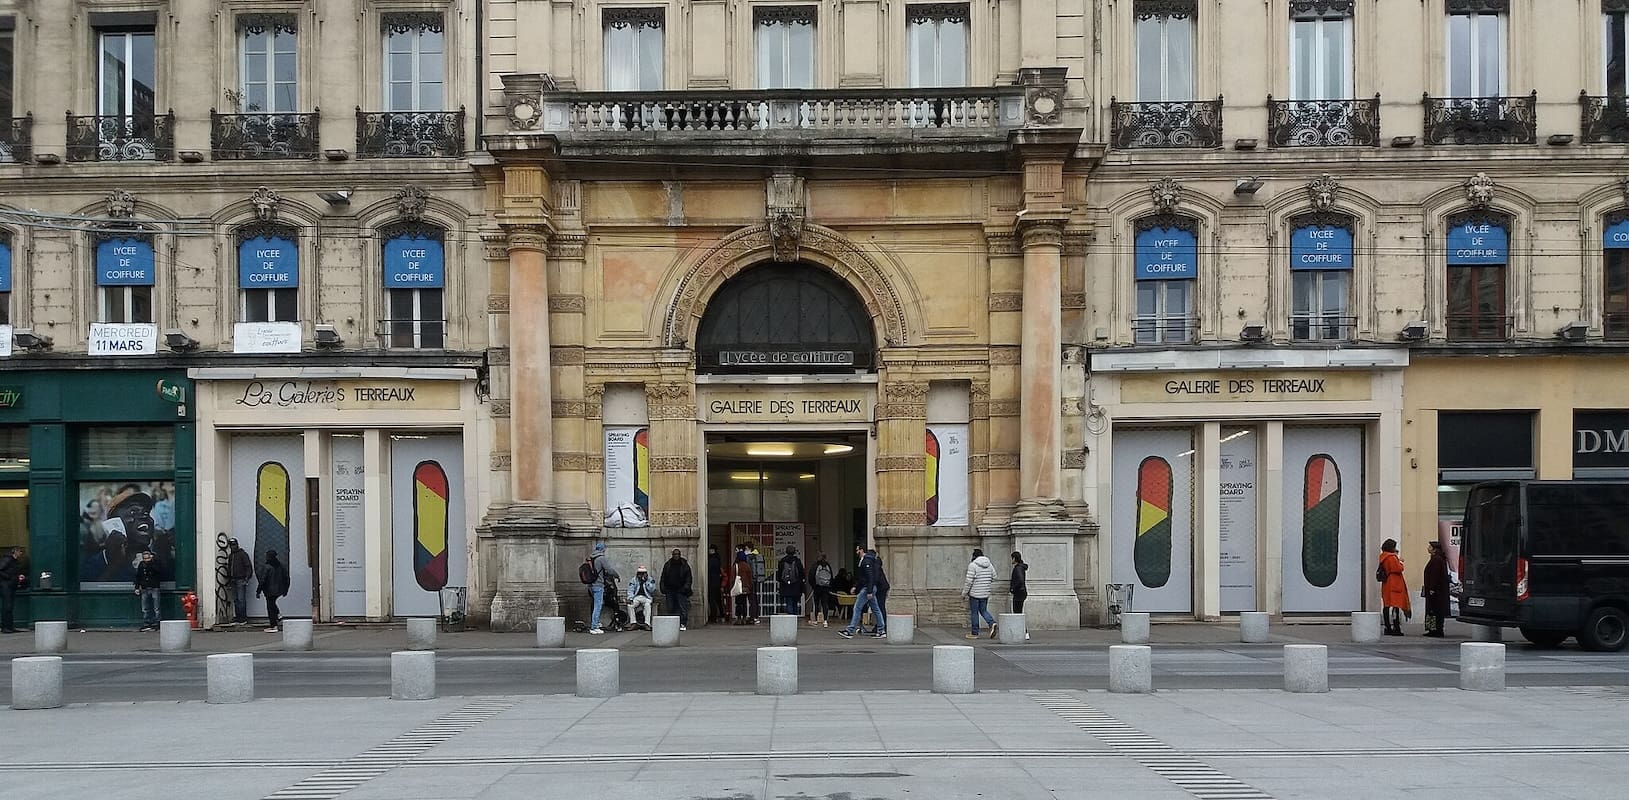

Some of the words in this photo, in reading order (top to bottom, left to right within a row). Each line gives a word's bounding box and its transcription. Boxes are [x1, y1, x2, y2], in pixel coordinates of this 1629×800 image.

[1472, 237, 1484, 246] DE
[1316, 242, 1328, 251] DE
[1161, 251, 1173, 260] DE
[1456, 249, 1498, 258] COIFFURE
[119, 258, 130, 267] DE
[1301, 254, 1342, 263] COIFFURE
[263, 261, 274, 270] DE
[408, 261, 420, 270] DE
[1146, 264, 1187, 273] COIFFURE
[106, 270, 145, 279] COIFFURE
[249, 273, 289, 282] COIFFURE
[394, 273, 434, 282] COIFFURE
[93, 327, 153, 338] MERCREDI
[96, 340, 107, 351] 11
[109, 340, 143, 351] MARS
[726, 351, 767, 364] Lycée
[772, 351, 787, 363] de
[1165, 380, 1220, 394] GALERIE
[1229, 380, 1254, 394] DES
[1262, 379, 1325, 393] TERREAUX
[236, 381, 273, 407] La
[278, 381, 335, 407] Galerie
[354, 388, 415, 401] TERREAUX
[710, 400, 762, 414] GALERIE
[770, 400, 795, 414] DES
[801, 400, 861, 413] TERREAUX
